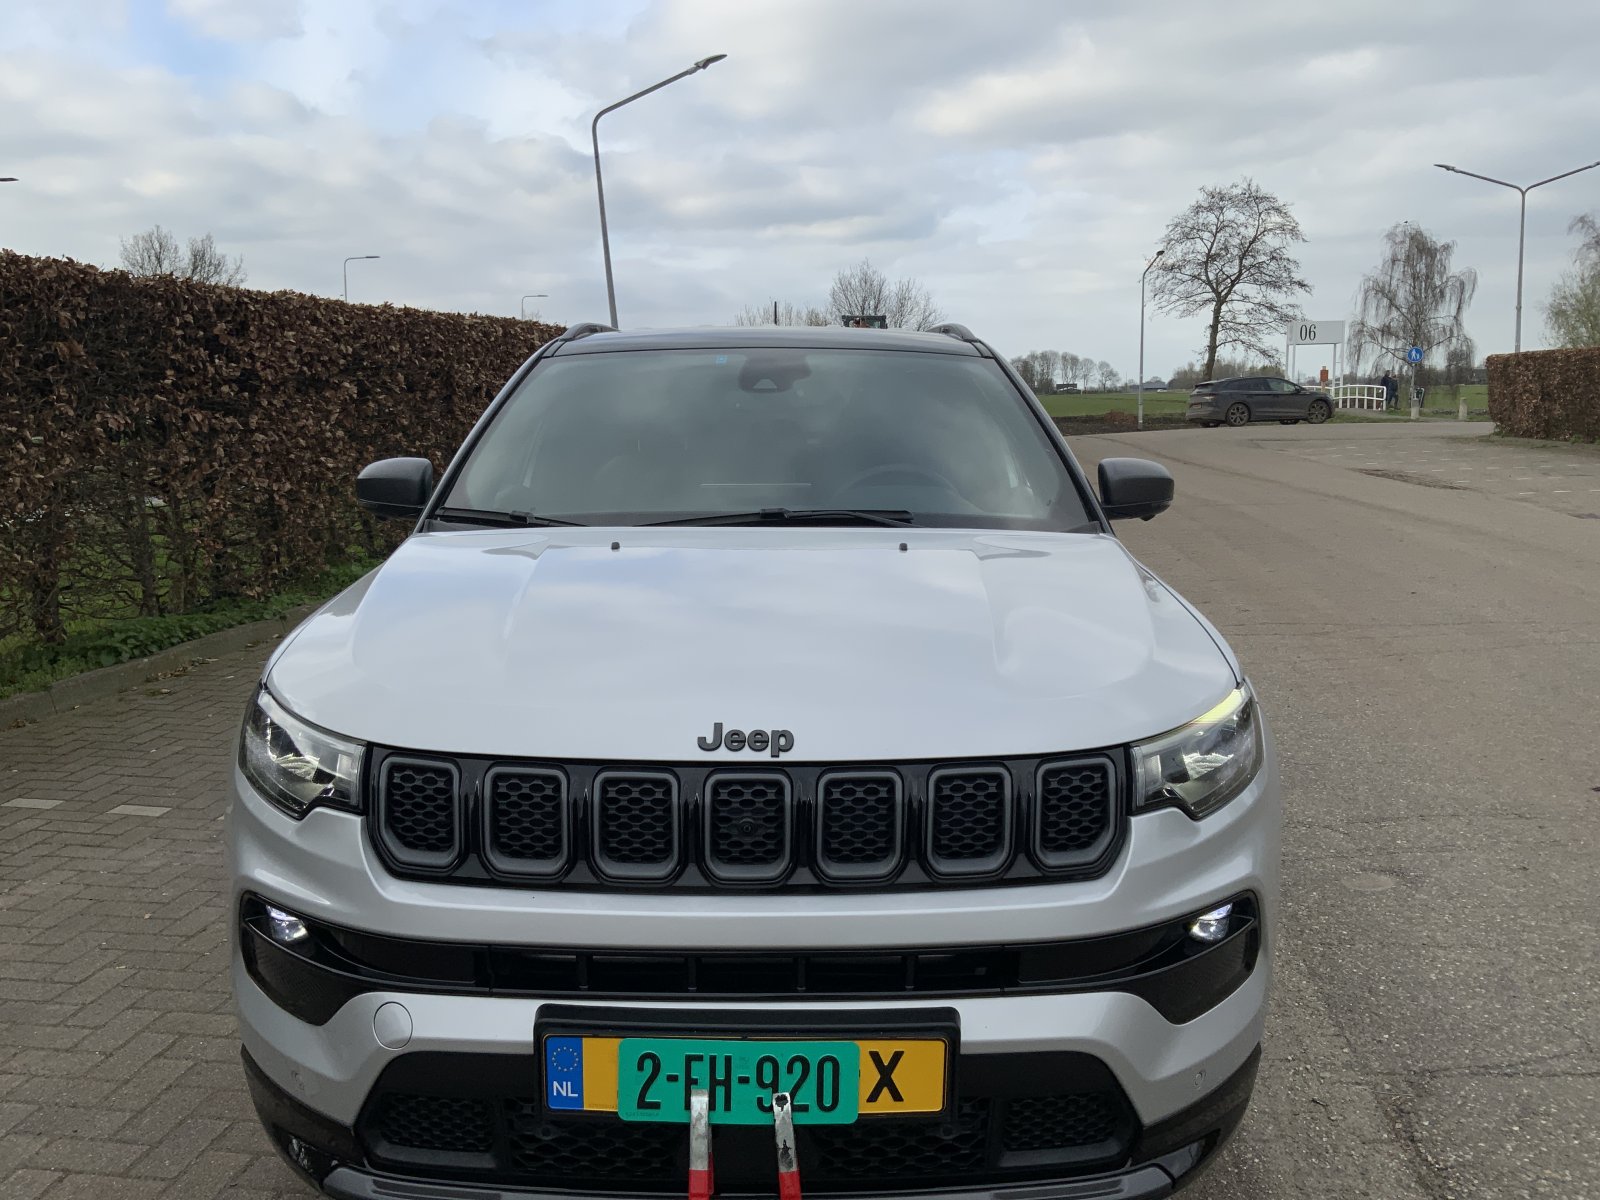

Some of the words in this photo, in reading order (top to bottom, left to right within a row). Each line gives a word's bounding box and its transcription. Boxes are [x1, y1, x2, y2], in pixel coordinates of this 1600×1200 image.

[1300, 323, 1317, 341] 06
[697, 722, 794, 758] Jeep
[552, 1080, 579, 1098] NL
[636, 1051, 842, 1113] 2-FH-920
[866, 1050, 905, 1103] X
